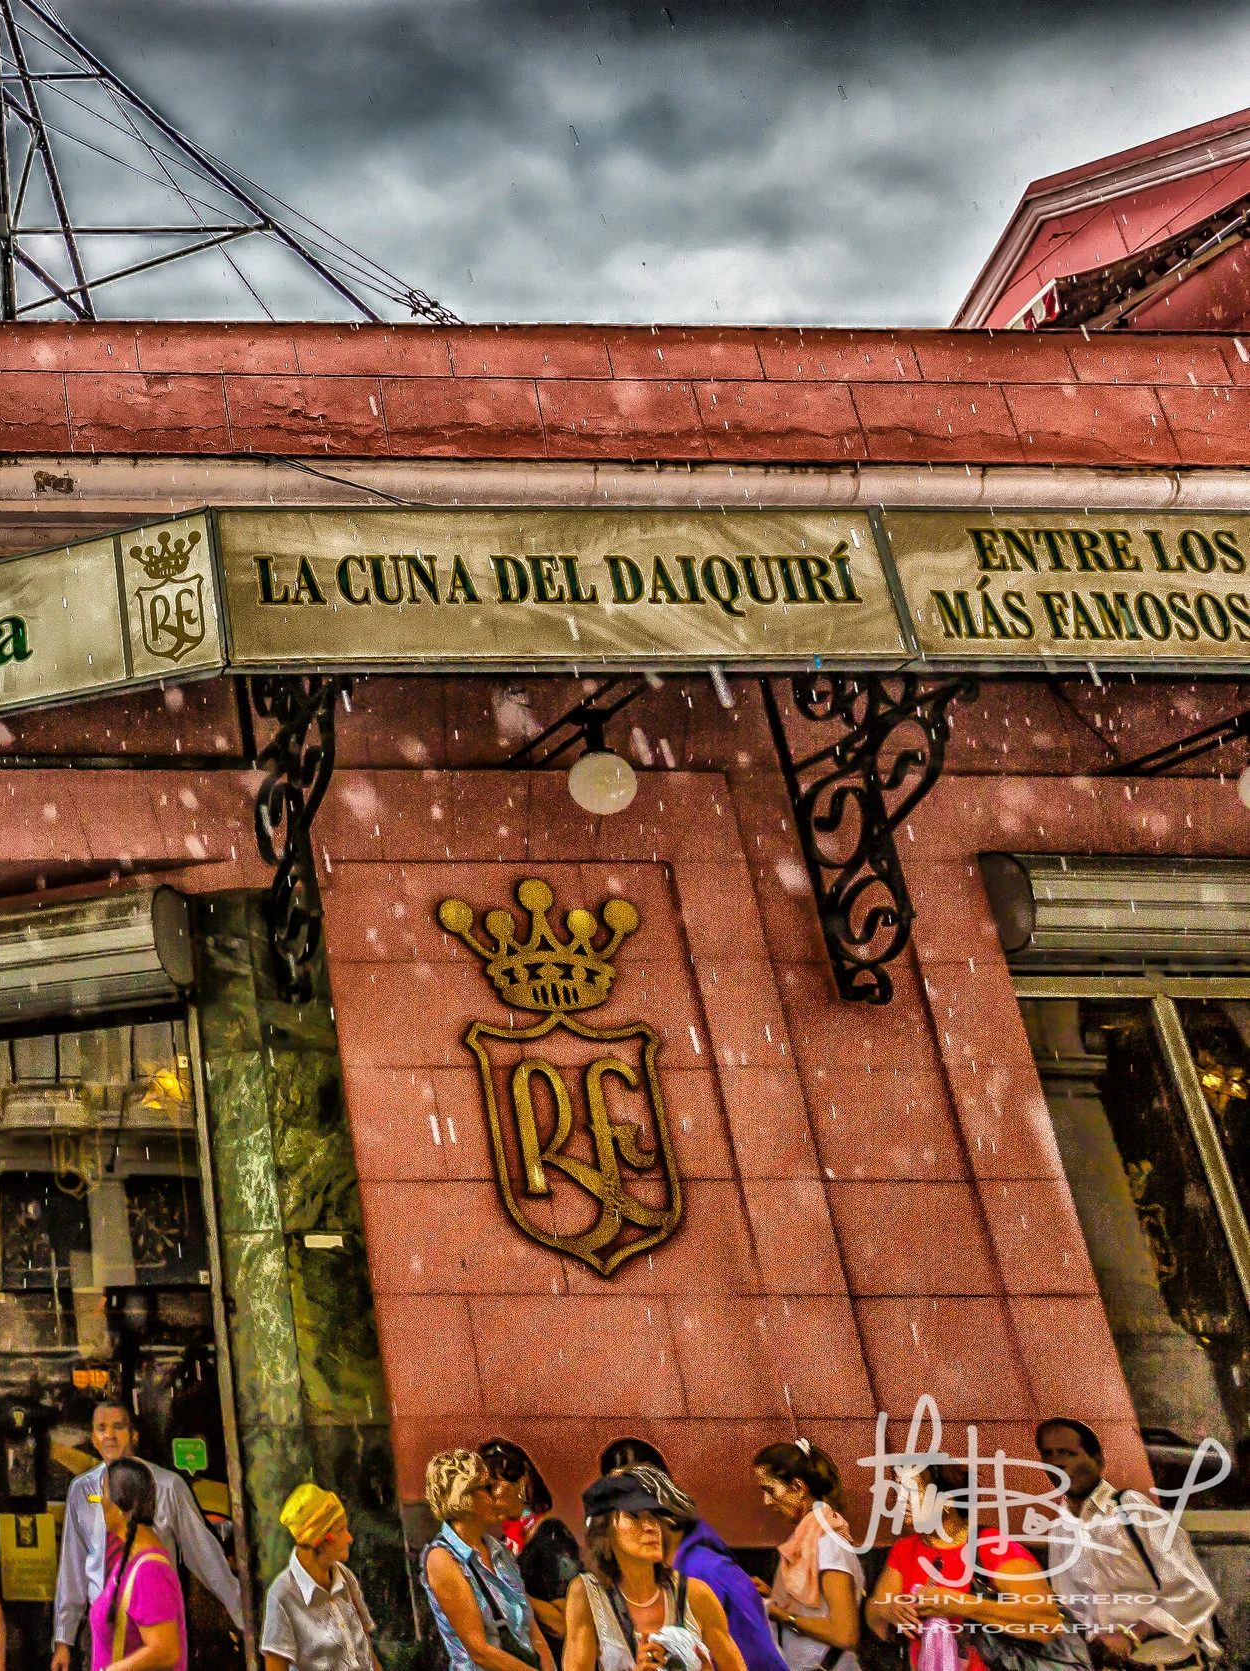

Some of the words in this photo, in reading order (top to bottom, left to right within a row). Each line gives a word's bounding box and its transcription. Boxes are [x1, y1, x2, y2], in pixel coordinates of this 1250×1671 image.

[254, 554, 327, 606] LA
[335, 553, 483, 606] CUNA
[490, 553, 599, 606] DEL
[604, 541, 863, 617] DAIQUIRÍ
[965, 527, 1143, 574] ENTRE
[1144, 529, 1247, 575] LOS
[929, 575, 1035, 641] MÁS
[1036, 590, 1250, 643] FAMOSOS
